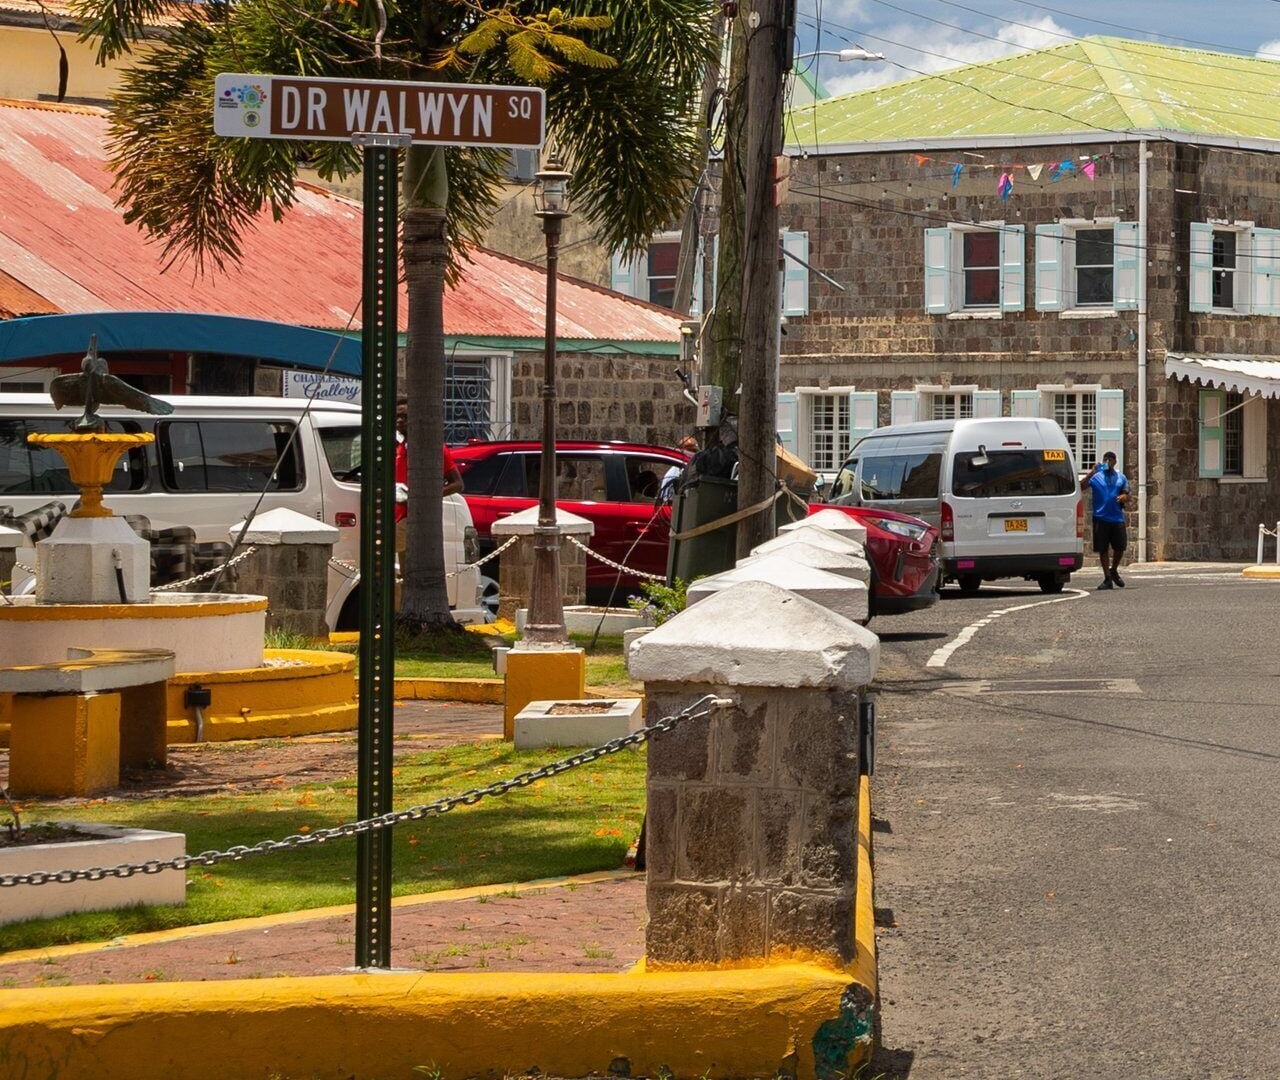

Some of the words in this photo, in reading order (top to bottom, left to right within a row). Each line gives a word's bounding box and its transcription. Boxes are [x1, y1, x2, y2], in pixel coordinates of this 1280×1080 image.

[281, 85, 327, 131] DR
[343, 87, 493, 138] WALWYN
[508, 95, 532, 120] SQ
[302, 382, 361, 400] Gallery
[1045, 450, 1065, 460] TAXI
